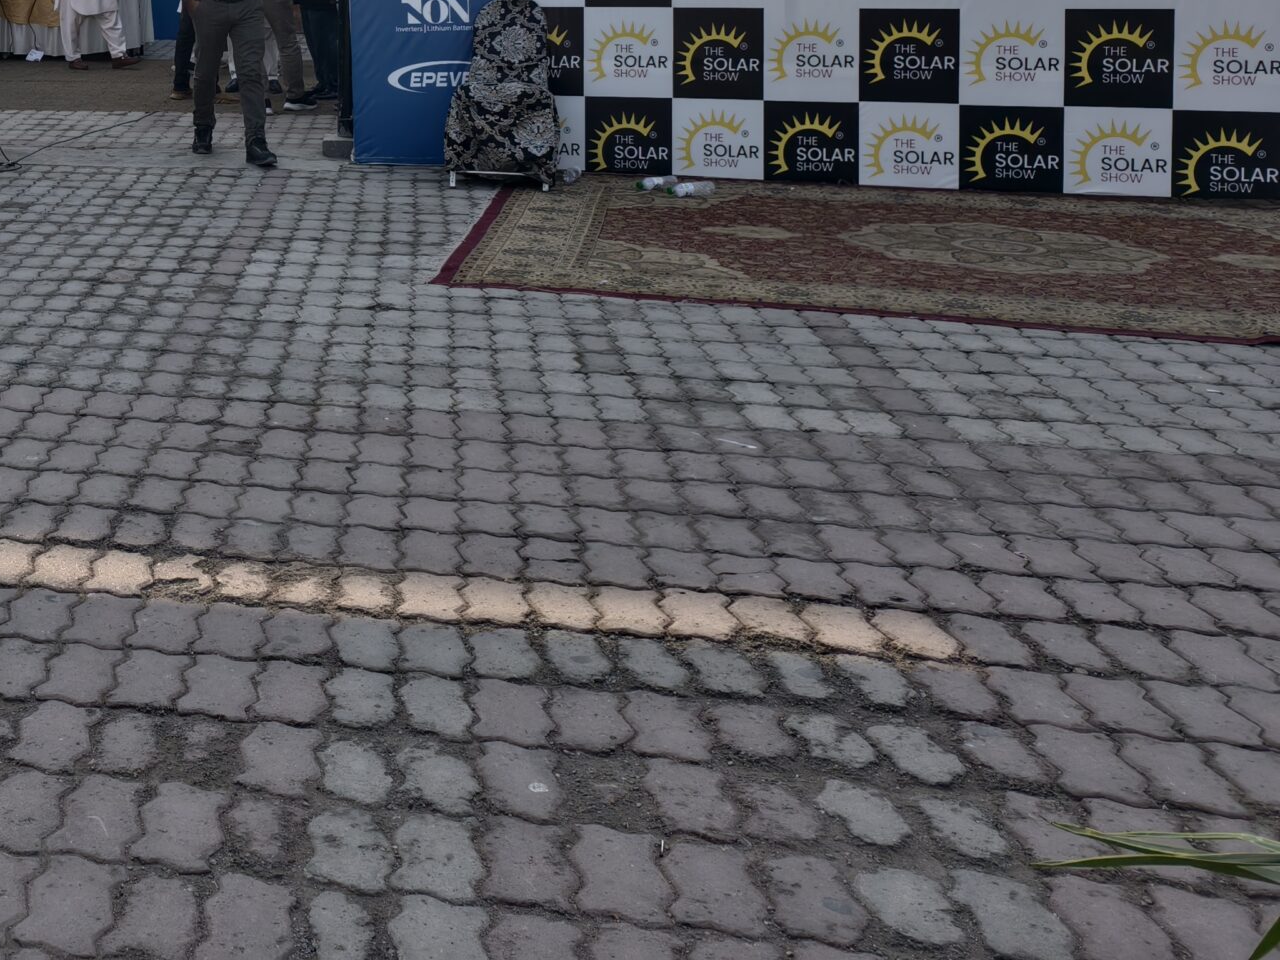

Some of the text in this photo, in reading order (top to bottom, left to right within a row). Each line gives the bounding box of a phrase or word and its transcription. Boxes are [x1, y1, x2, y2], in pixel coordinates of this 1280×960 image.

[427, 24, 451, 32] Lithium
[894, 43, 917, 54] THE
[893, 55, 955, 70] SOLAR
[893, 70, 933, 80] SHOW
[1210, 153, 1235, 165] THE
[1209, 166, 1280, 183] SOLAR
[1209, 181, 1254, 193] SHOW
